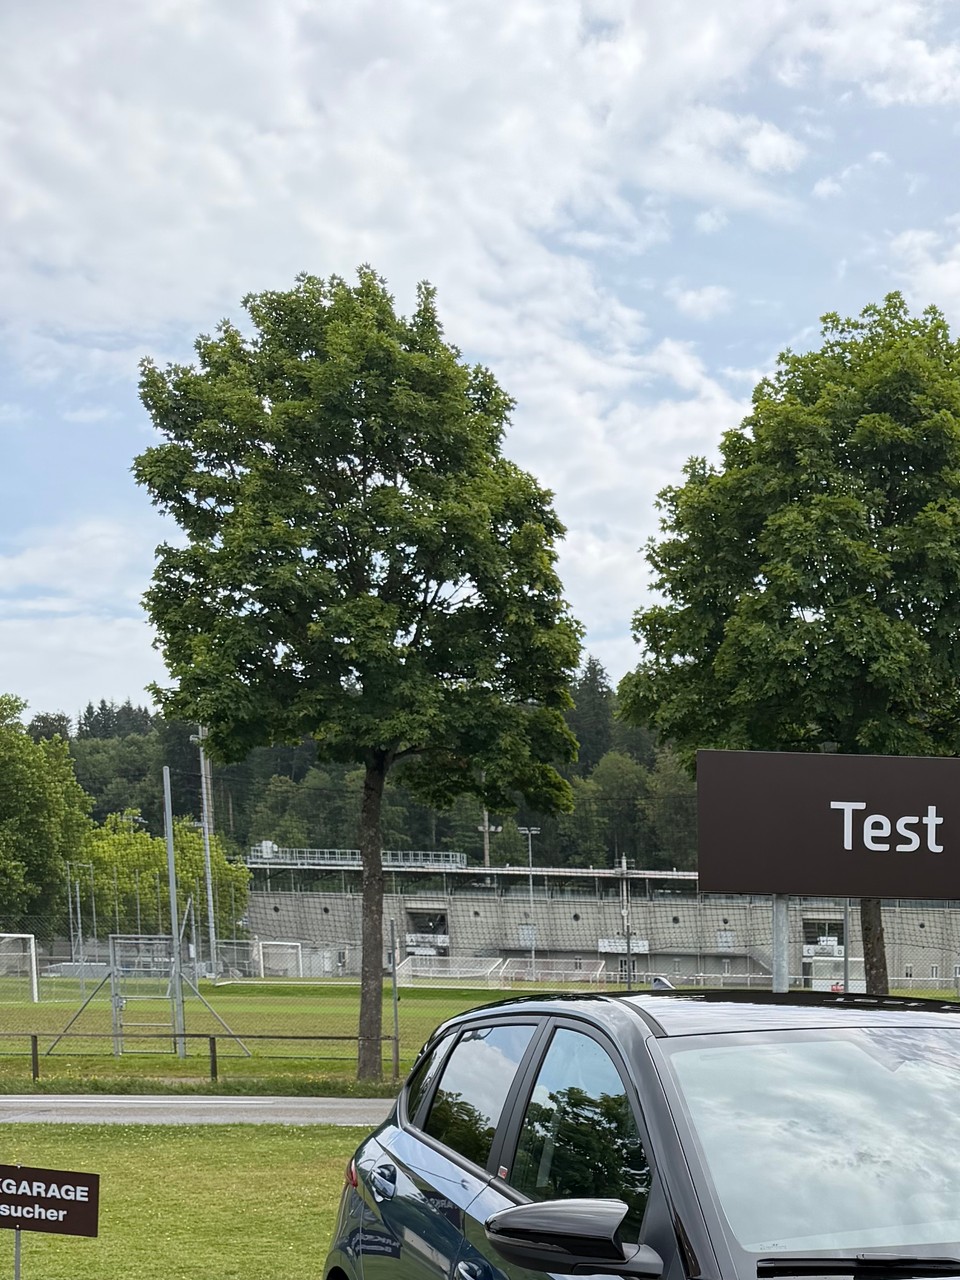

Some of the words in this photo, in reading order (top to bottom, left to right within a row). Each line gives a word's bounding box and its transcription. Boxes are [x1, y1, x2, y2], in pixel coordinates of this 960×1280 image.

[830, 801, 944, 853] Test
[0, 1178, 89, 1202] GARAGE
[0, 1204, 67, 1221] sucher
